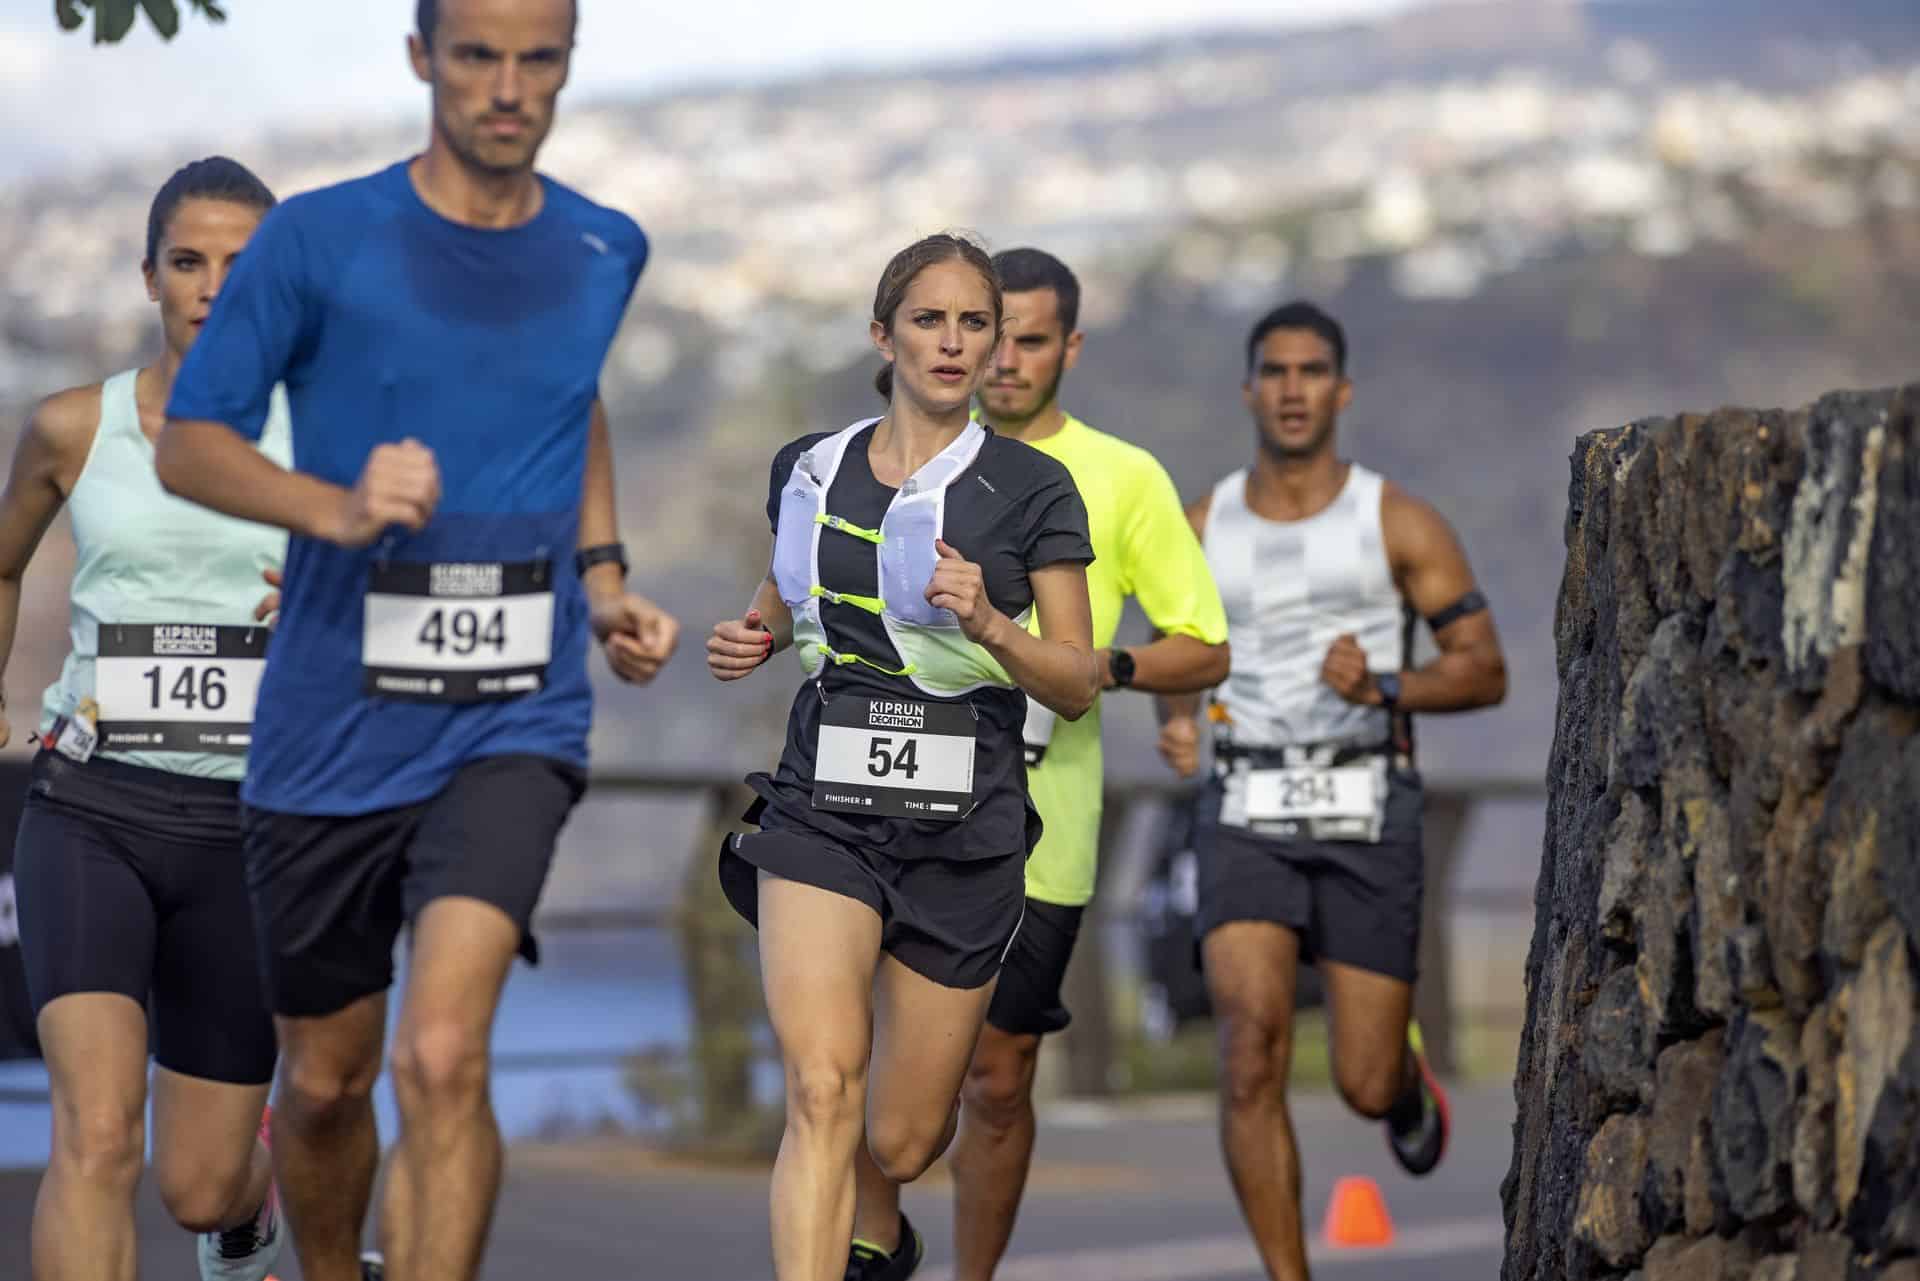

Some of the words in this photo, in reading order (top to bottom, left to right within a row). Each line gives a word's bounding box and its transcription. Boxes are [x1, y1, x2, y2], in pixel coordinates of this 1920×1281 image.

[153, 625, 217, 641] KIPRUN
[418, 607, 506, 655] 494
[143, 665, 227, 710] 146
[869, 700, 925, 717] KIPRUN
[871, 714, 922, 728] DECATHLON
[867, 736, 919, 780] 54
